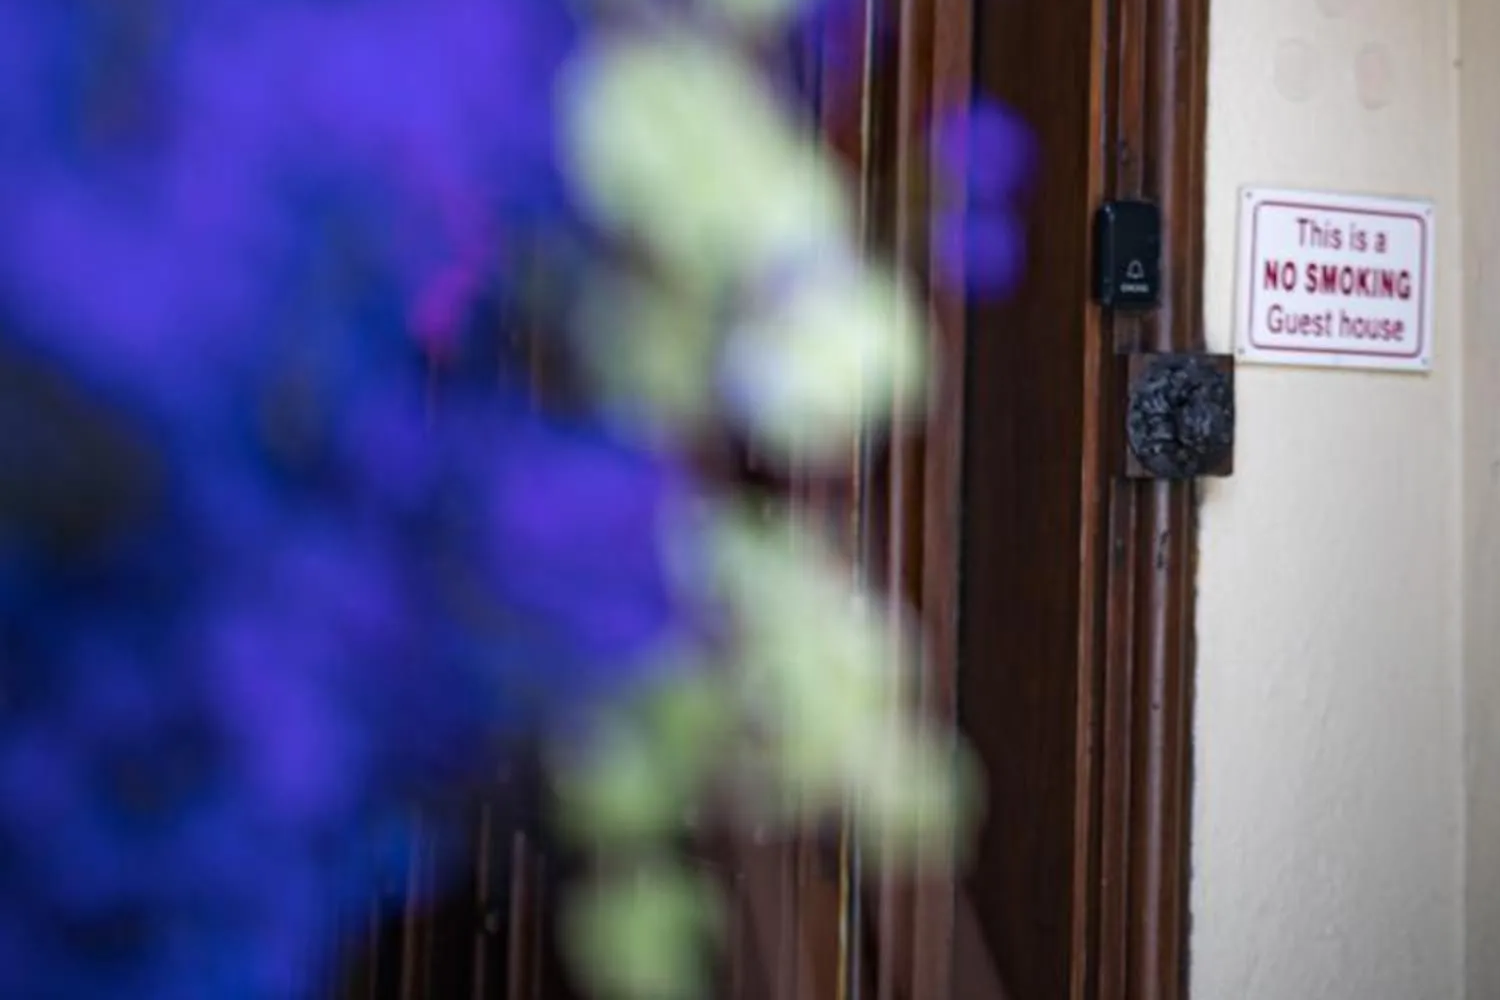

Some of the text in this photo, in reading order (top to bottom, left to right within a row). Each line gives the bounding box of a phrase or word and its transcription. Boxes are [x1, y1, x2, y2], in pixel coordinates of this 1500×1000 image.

[1296, 217, 1386, 254] This is a
[1263, 260, 1411, 300] NO SMOKING
[1267, 303, 1404, 341] Guest house
